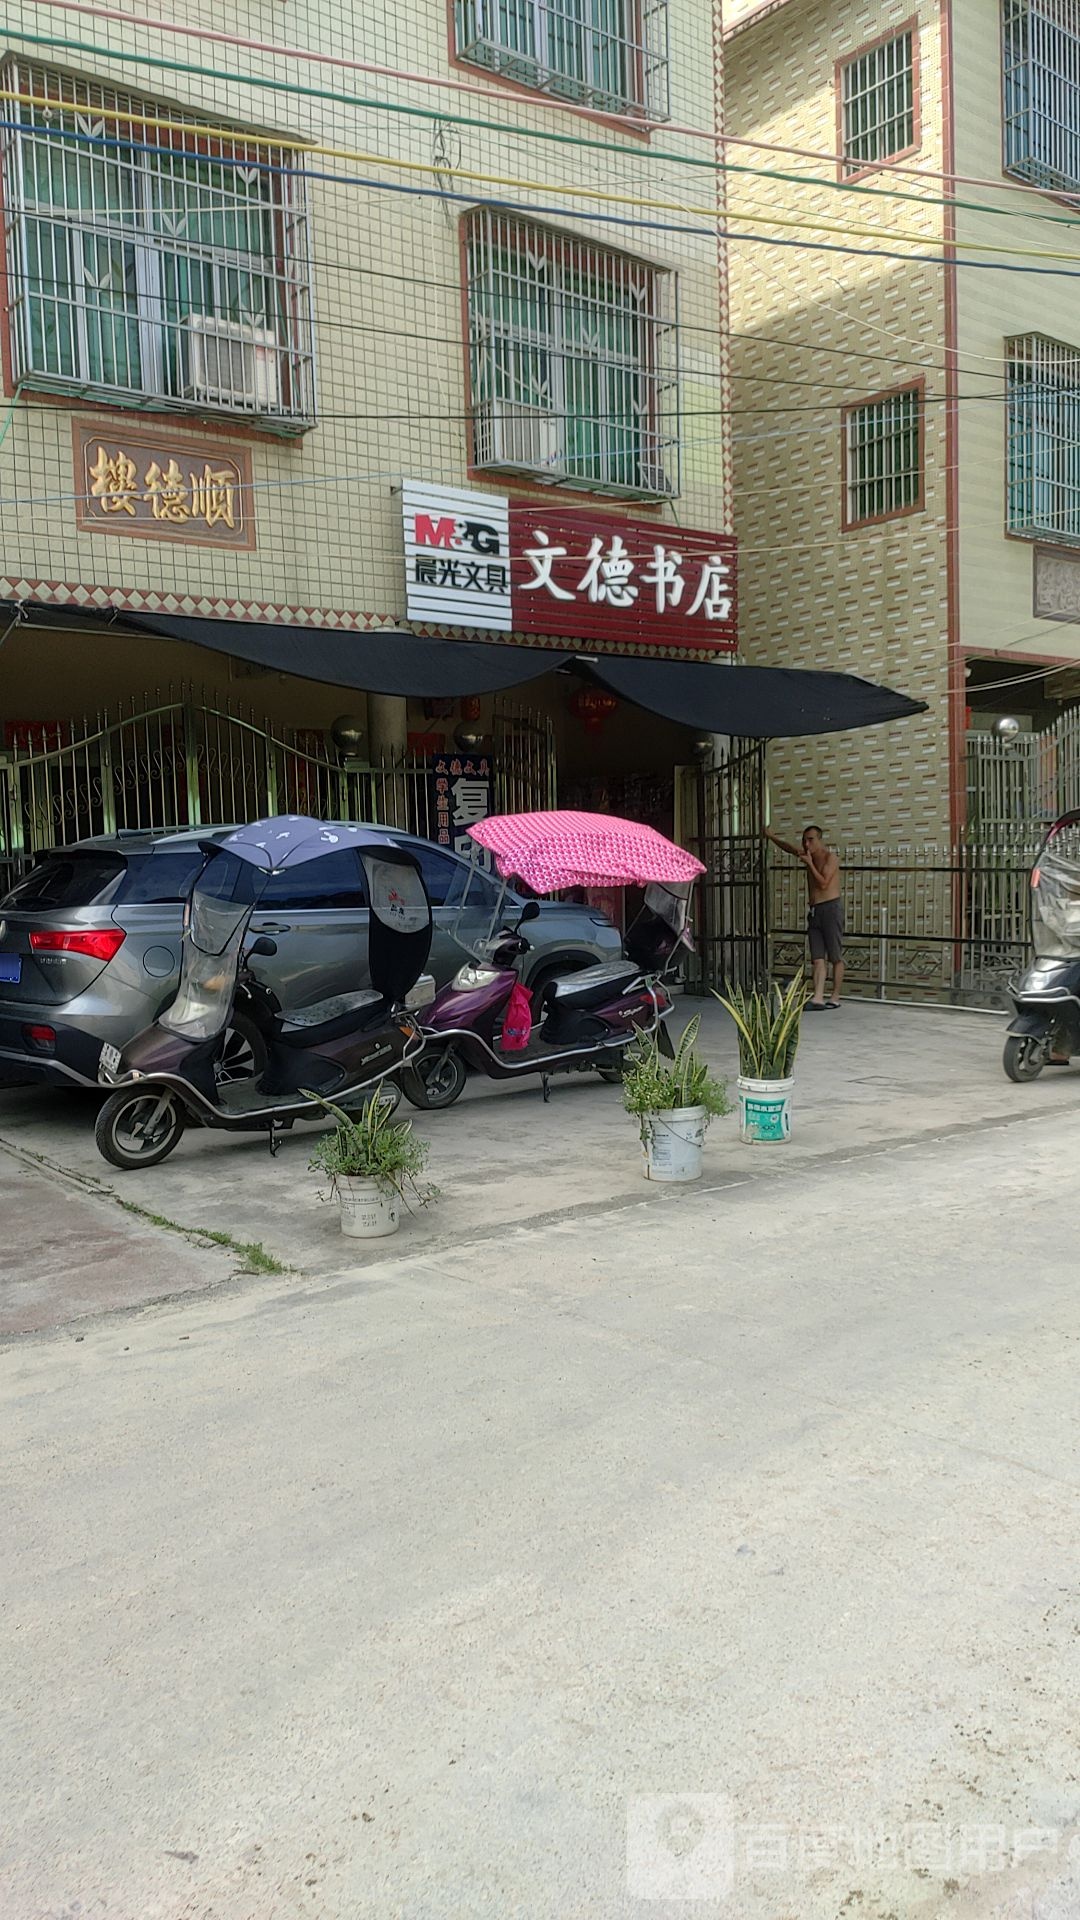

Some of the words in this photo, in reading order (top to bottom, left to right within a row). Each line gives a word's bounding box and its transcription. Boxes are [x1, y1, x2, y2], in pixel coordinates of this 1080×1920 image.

[415, 554, 508, 593] 晨光文具
[518, 530, 733, 620] 文德书店
[436, 778, 450, 844] 学生用品
